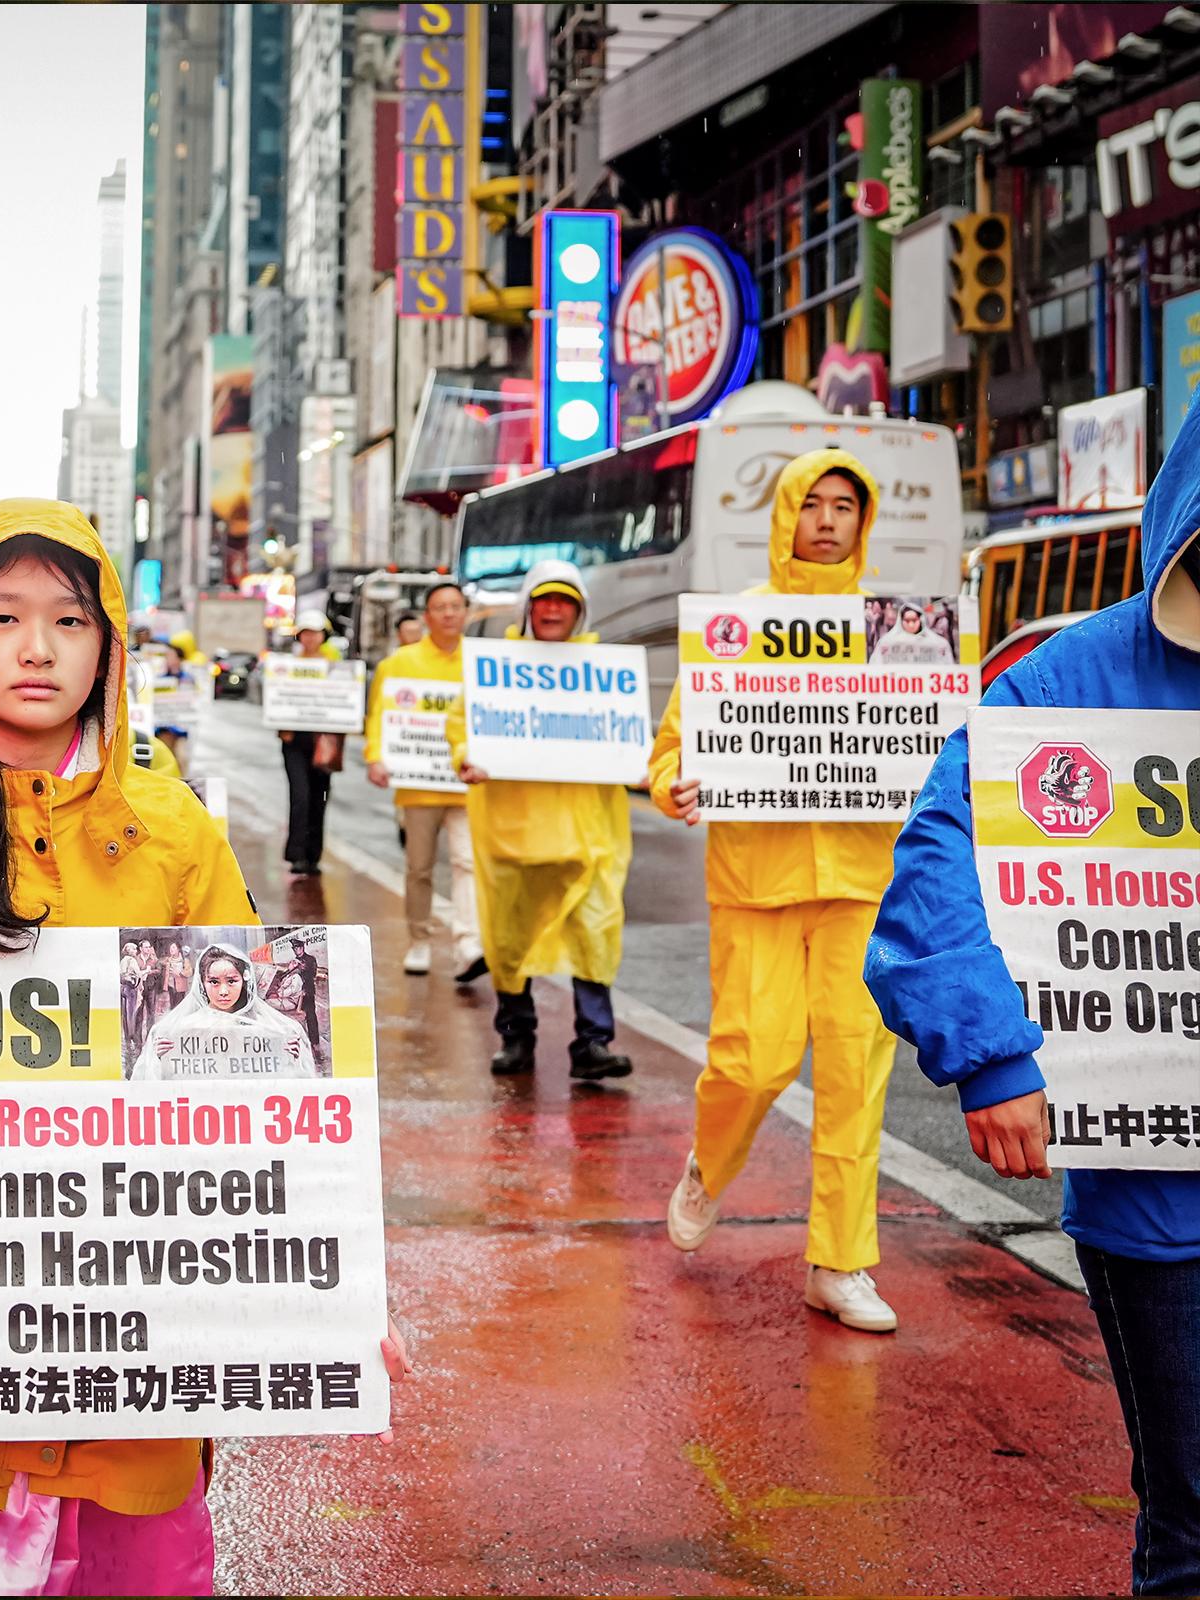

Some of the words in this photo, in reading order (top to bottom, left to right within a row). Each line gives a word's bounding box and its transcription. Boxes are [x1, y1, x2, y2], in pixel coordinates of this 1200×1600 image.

[628, 273, 694, 345] DAVE
[691, 269, 716, 311] &
[762, 619, 852, 659] SOS!
[476, 656, 637, 694] Dissolve
[691, 671, 728, 693] U.S.
[735, 673, 801, 693] House
[807, 672, 924, 694] Resolution
[929, 673, 969, 695] 343
[471, 702, 526, 738] Chinese
[529, 705, 607, 742] Communist
[609, 709, 644, 748] Party
[720, 700, 849, 725] Condemns
[857, 701, 939, 725] Forced
[697, 730, 743, 754] Live
[751, 730, 821, 757] Organ
[789, 762, 809, 783] In
[816, 762, 877, 784] China
[1042, 805, 1099, 827] STOP
[998, 861, 1074, 907] U.S.
[243, 1035, 273, 1054] FOR
[171, 1057, 219, 1075] THEIR
[230, 1055, 281, 1074] BELIEF
[263, 1094, 353, 1145] 343
[1047, 1103, 1200, 1148] 止中共
[102, 1160, 287, 1217] Forced
[41, 1228, 340, 1290] Harvesting
[8, 1303, 148, 1354] China
